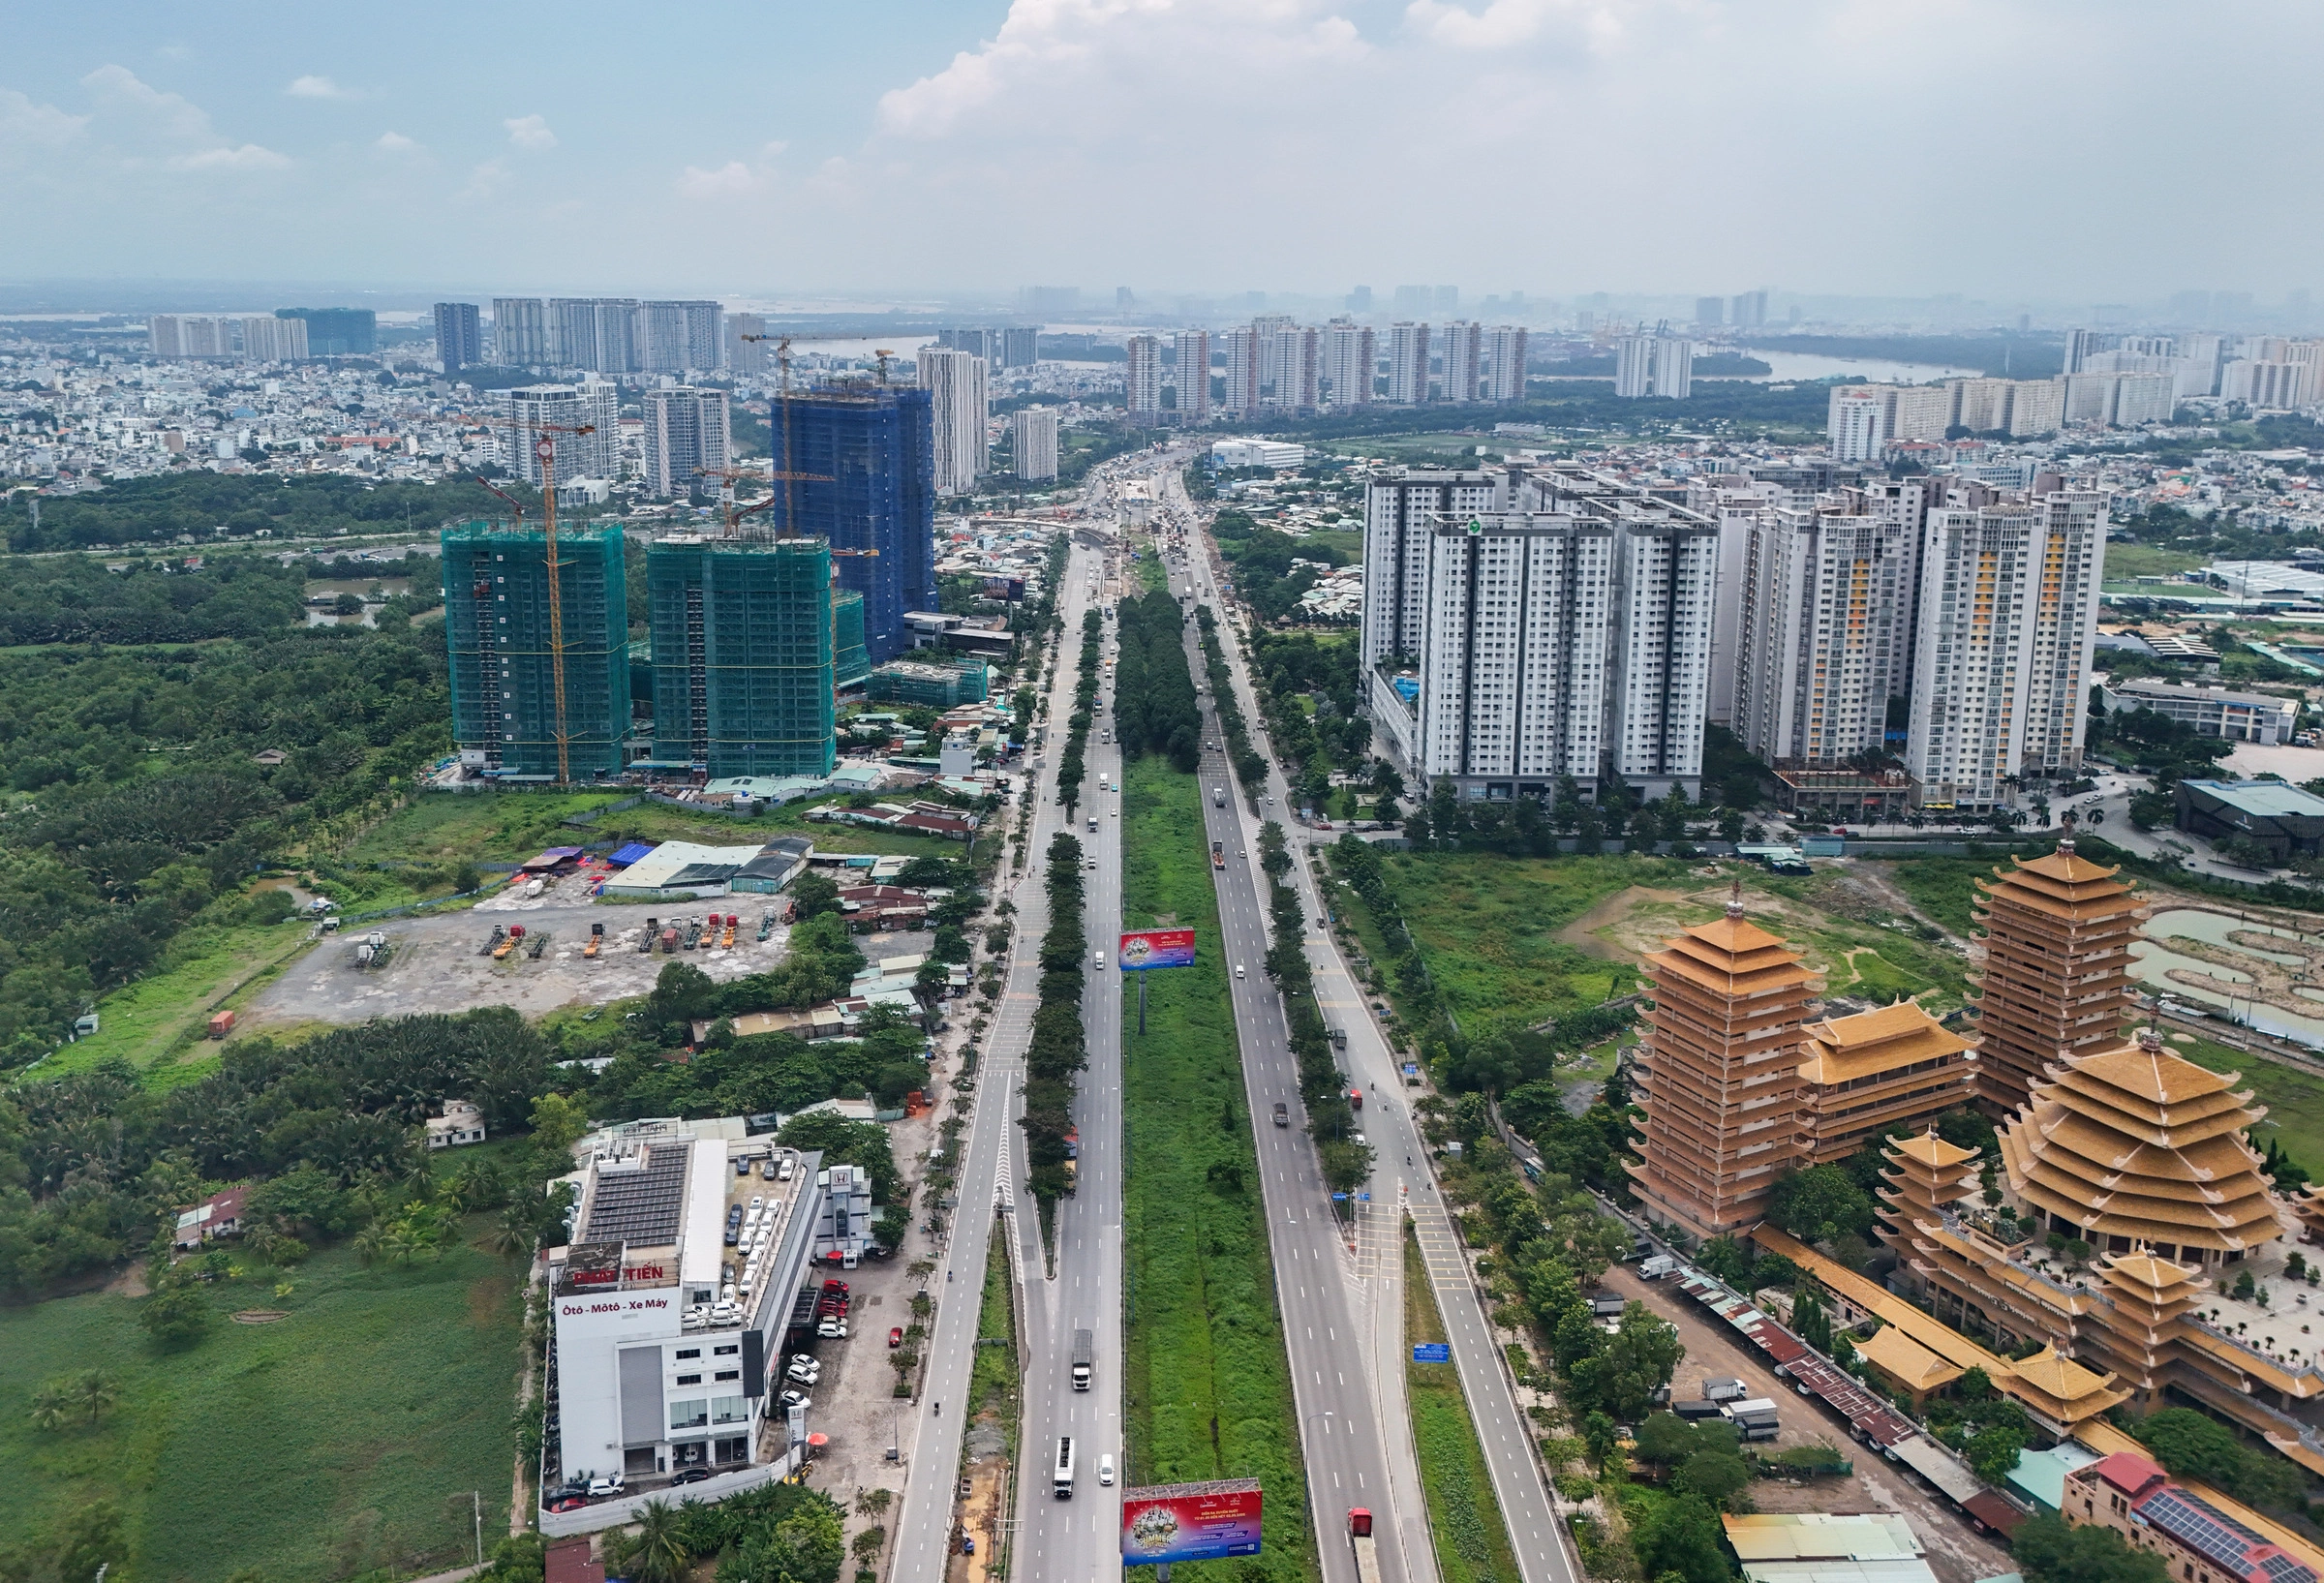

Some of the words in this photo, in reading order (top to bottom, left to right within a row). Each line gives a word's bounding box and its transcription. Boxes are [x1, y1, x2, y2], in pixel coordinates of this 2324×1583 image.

[626, 1262, 663, 1281] TIẾN
[563, 1303, 584, 1316] Ôtô
[591, 1302, 621, 1314] Môtô
[629, 1301, 642, 1310] Xe
[645, 1298, 668, 1309] Máy
